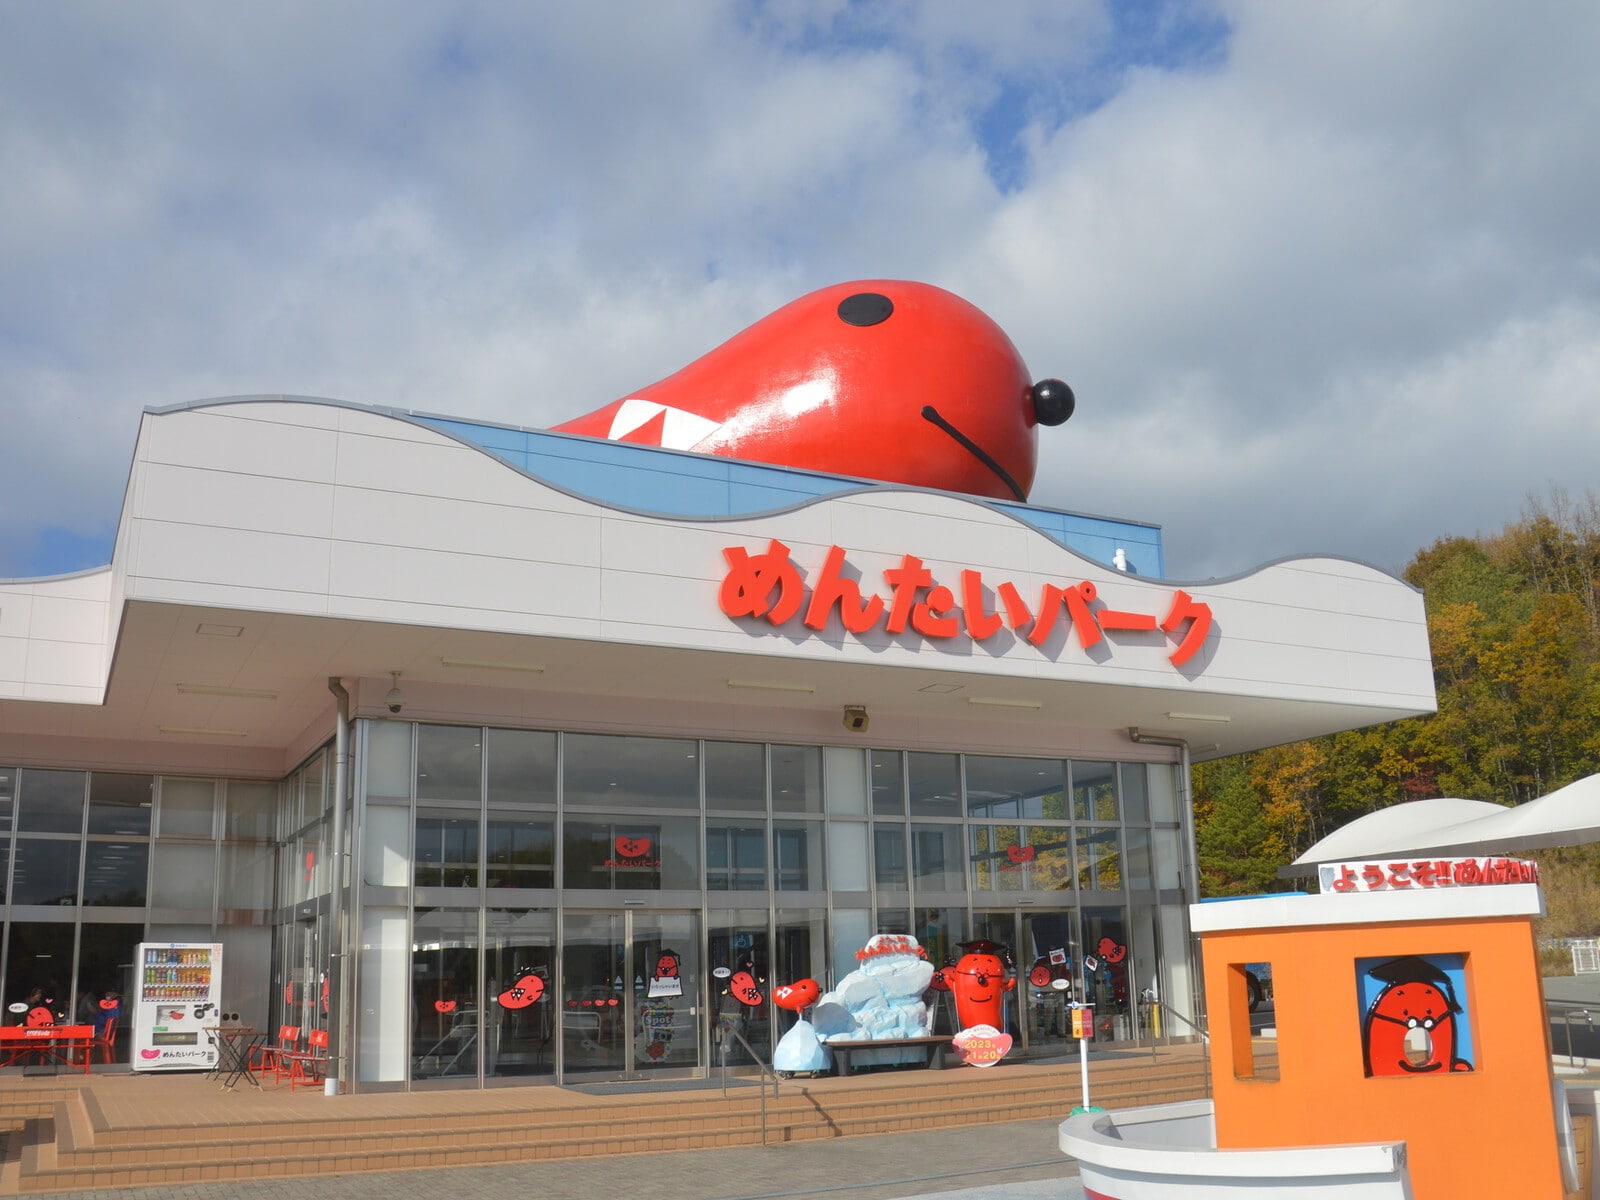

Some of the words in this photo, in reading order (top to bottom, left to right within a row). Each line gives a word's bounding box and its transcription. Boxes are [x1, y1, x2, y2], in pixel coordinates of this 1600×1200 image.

[717, 538, 1213, 667] めんたいパーク
[162, 1050, 207, 1058] めんたいパーク
